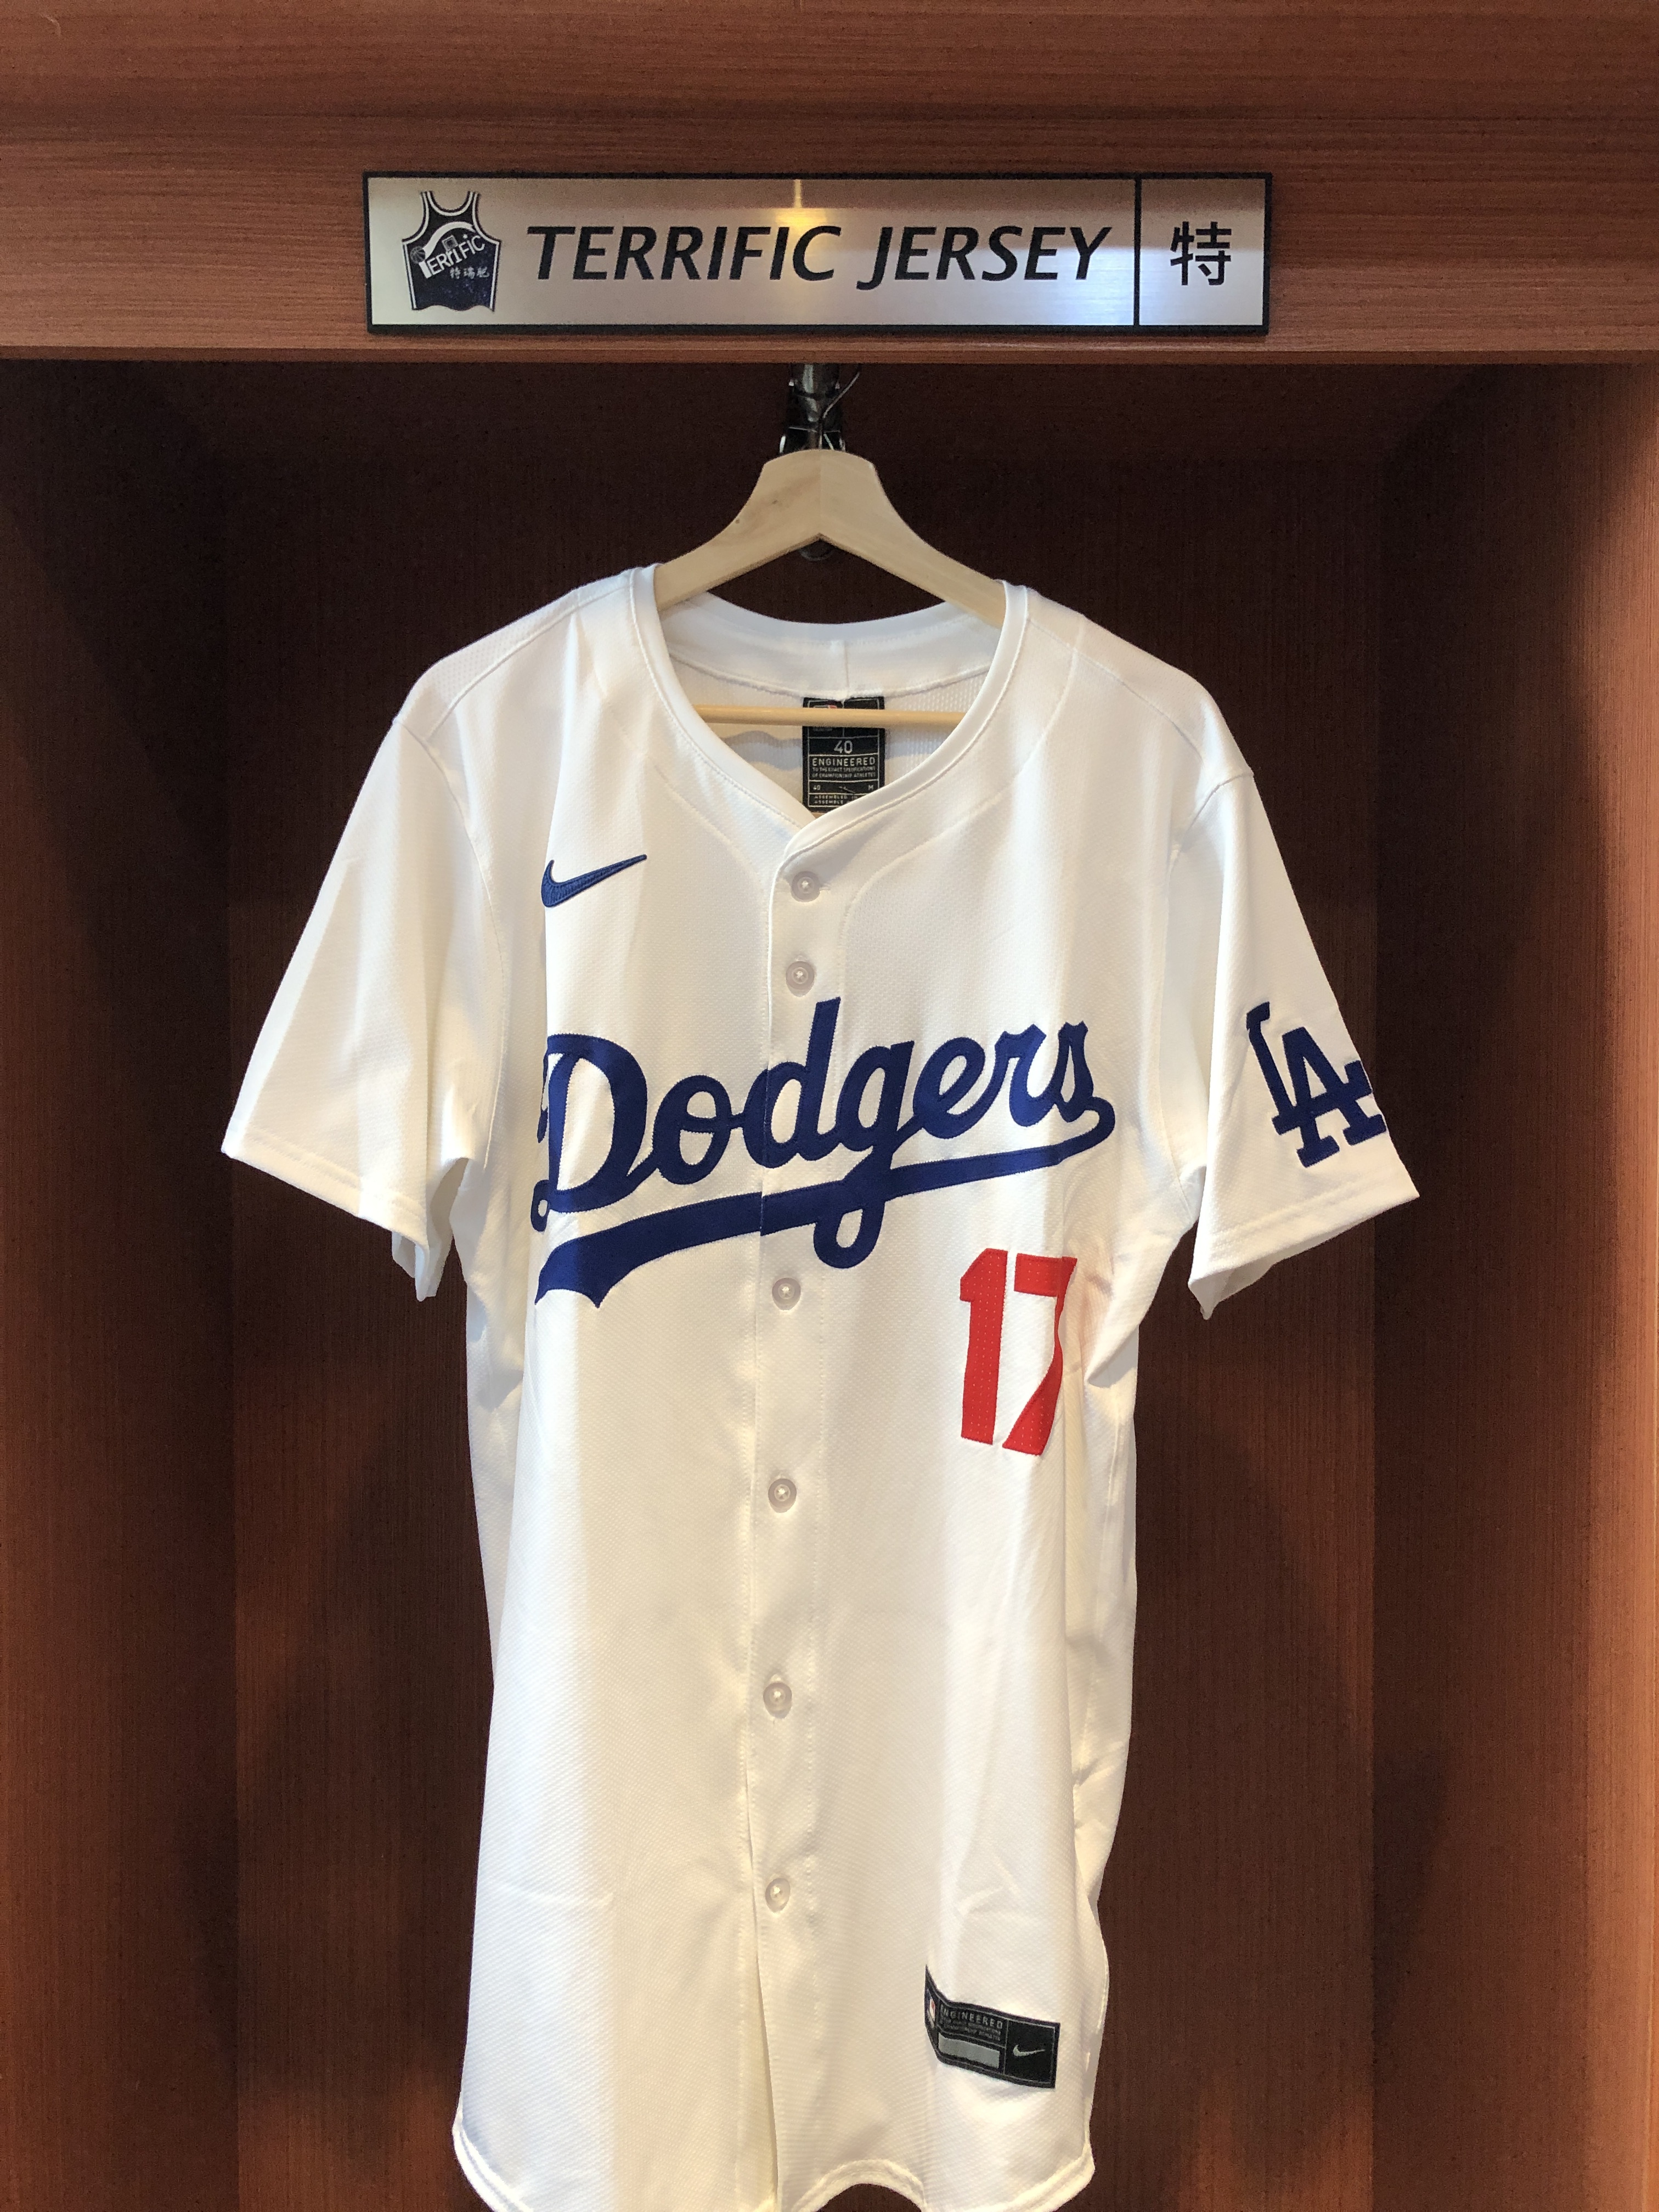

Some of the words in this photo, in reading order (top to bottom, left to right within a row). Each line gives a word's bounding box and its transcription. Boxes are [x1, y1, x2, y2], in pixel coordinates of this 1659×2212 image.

[527, 225, 842, 281] TERRIFIC
[856, 226, 1113, 290] JERSEY
[1170, 221, 1232, 285] 特
[812, 757, 876, 766] ENGINEERED
[833, 740, 853, 754] 40
[1246, 1001, 1387, 1168] LA
[531, 997, 1115, 1269] Dodgers
[960, 1248, 1077, 1456] 17
[940, 2004, 1003, 2029] ENGINEERED
